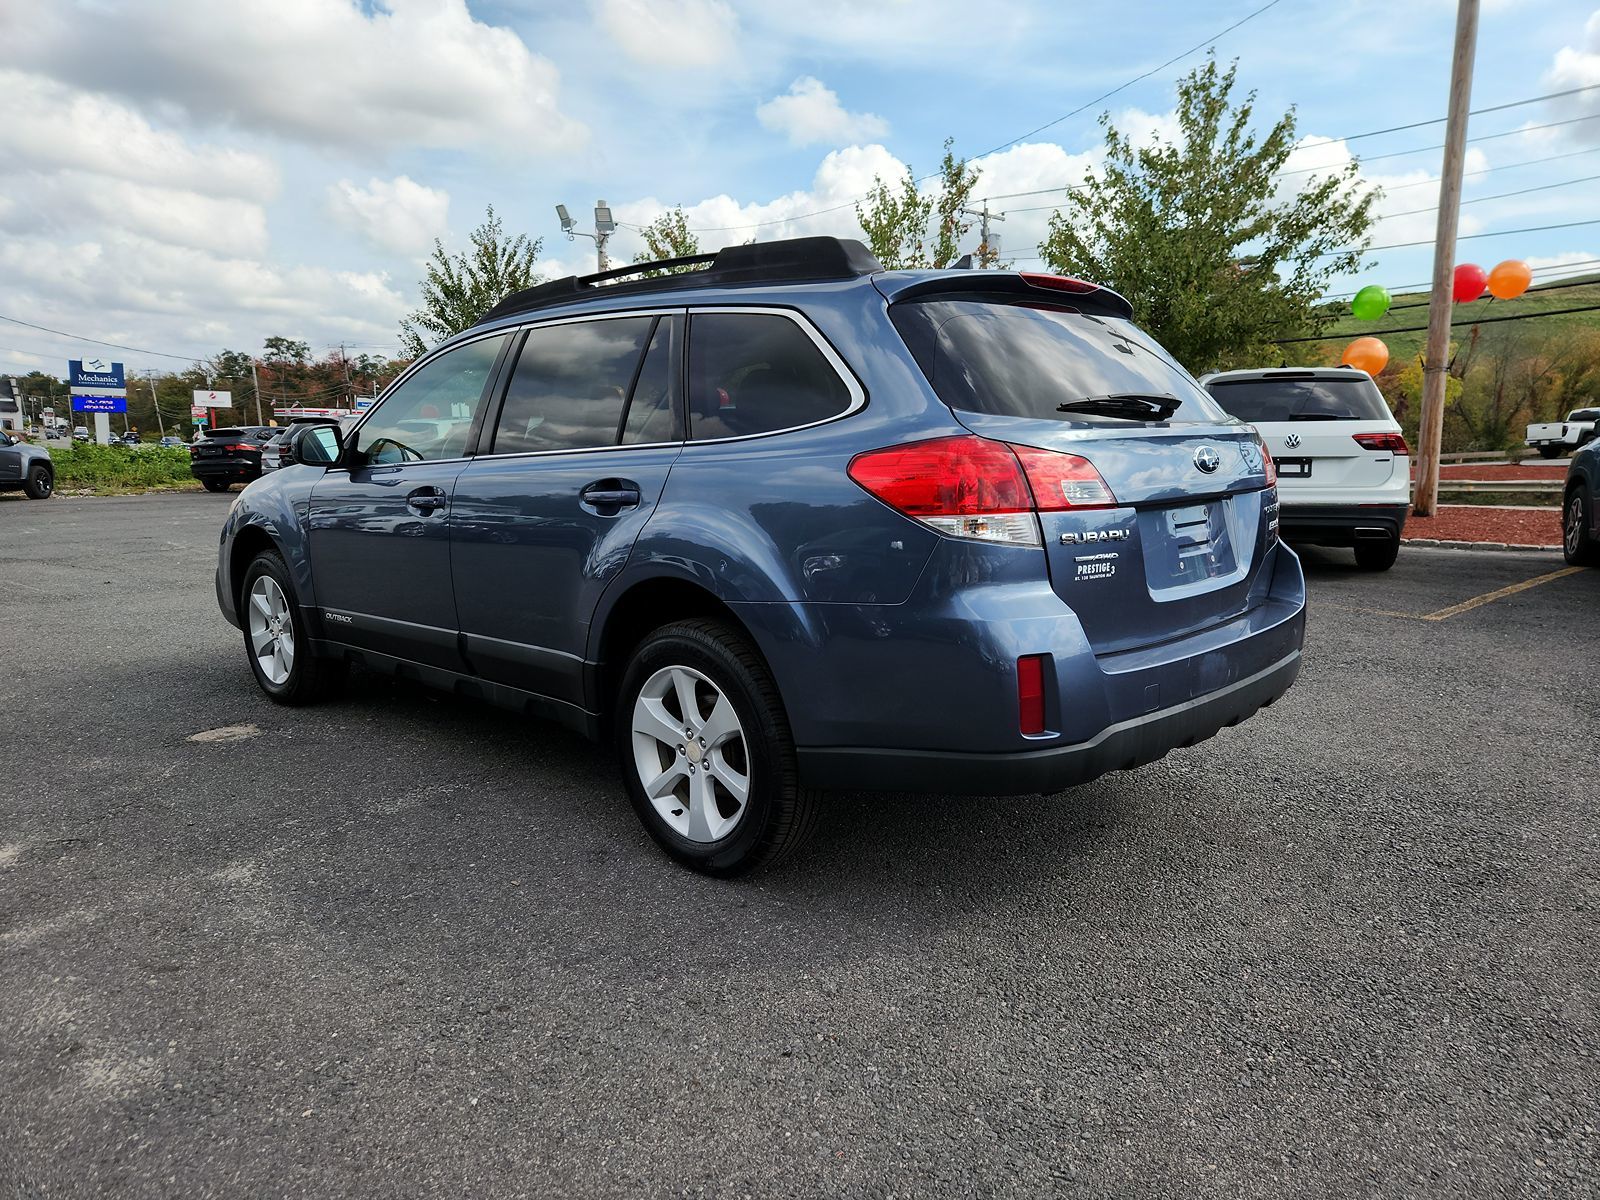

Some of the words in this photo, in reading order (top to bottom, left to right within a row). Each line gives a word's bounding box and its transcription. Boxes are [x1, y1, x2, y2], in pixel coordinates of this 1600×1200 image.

[78, 374, 118, 383] Mechanics
[1060, 529, 1130, 545] SUBARU
[1093, 552, 1119, 561] AWD
[1077, 562, 1111, 575] PRESTIGE
[326, 612, 352, 624] OUTBACK
